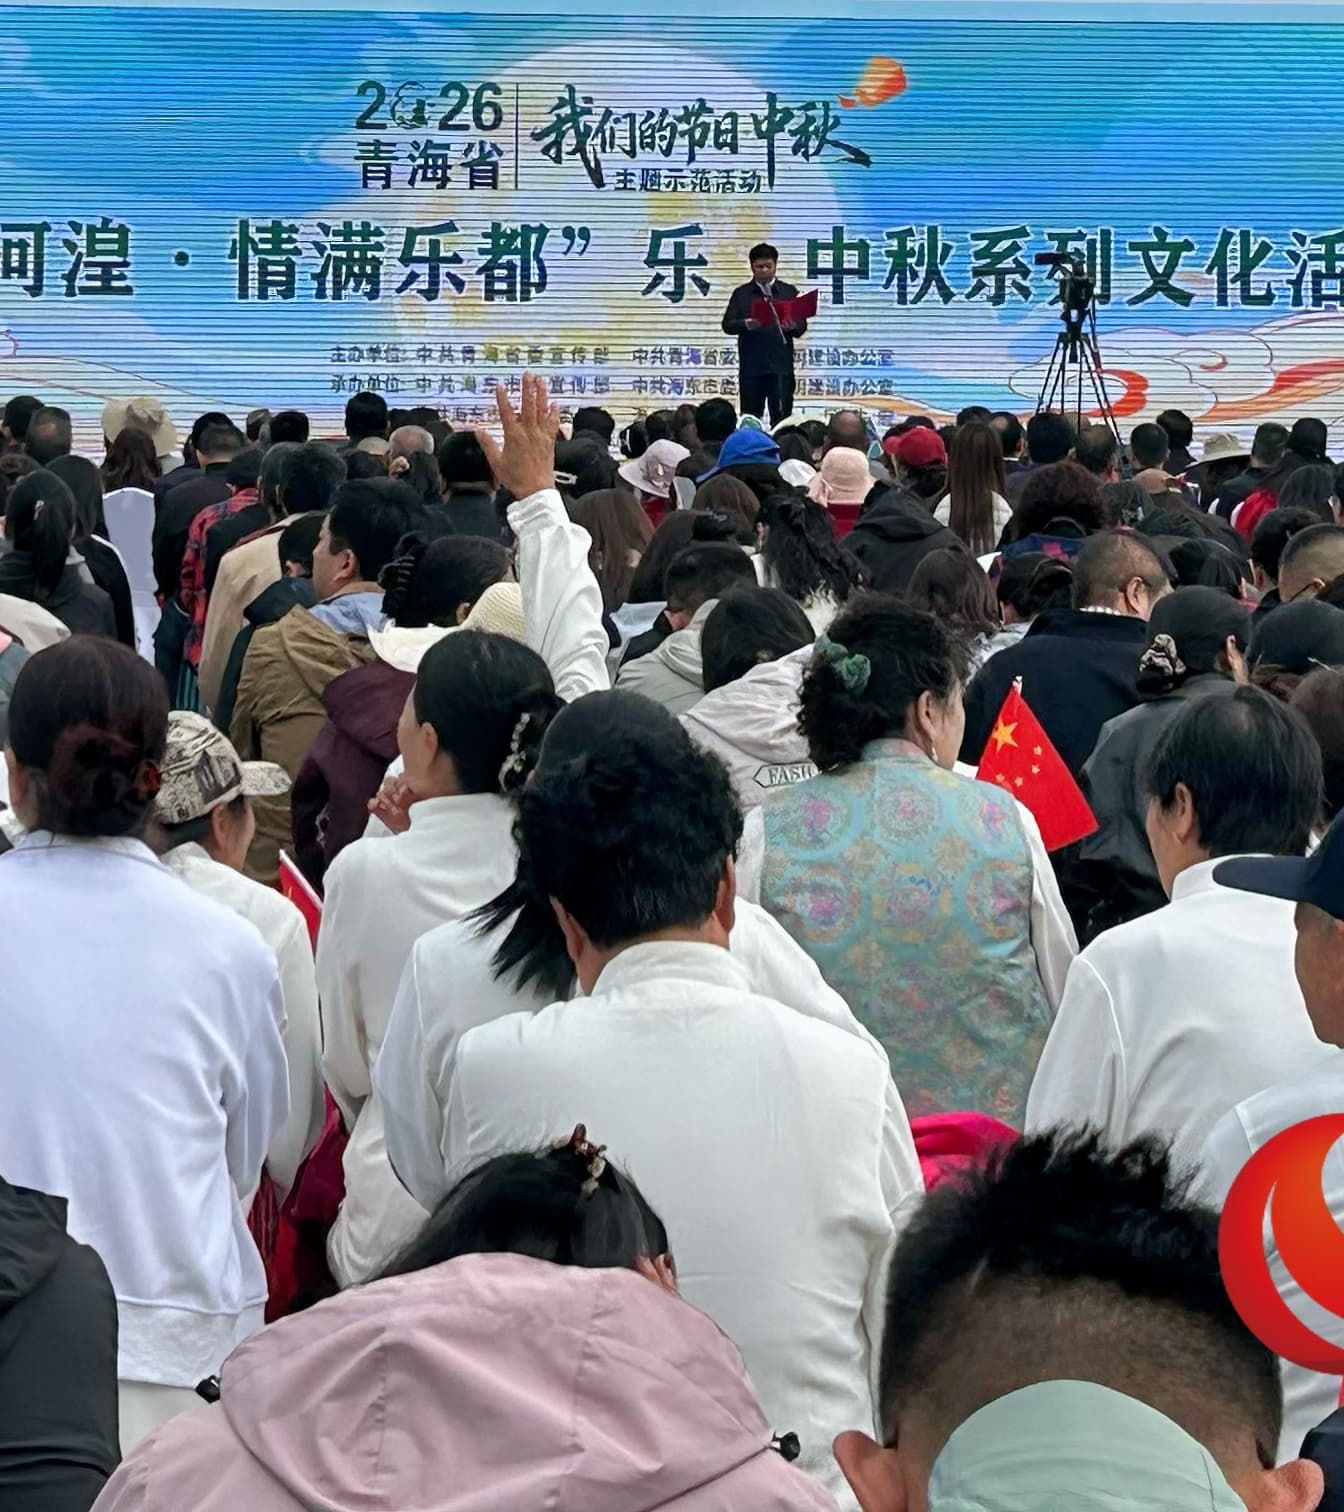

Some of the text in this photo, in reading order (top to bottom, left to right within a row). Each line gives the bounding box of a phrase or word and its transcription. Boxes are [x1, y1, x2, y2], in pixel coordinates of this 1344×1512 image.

[356, 80, 503, 131] 2026
[354, 139, 504, 190] 青海省
